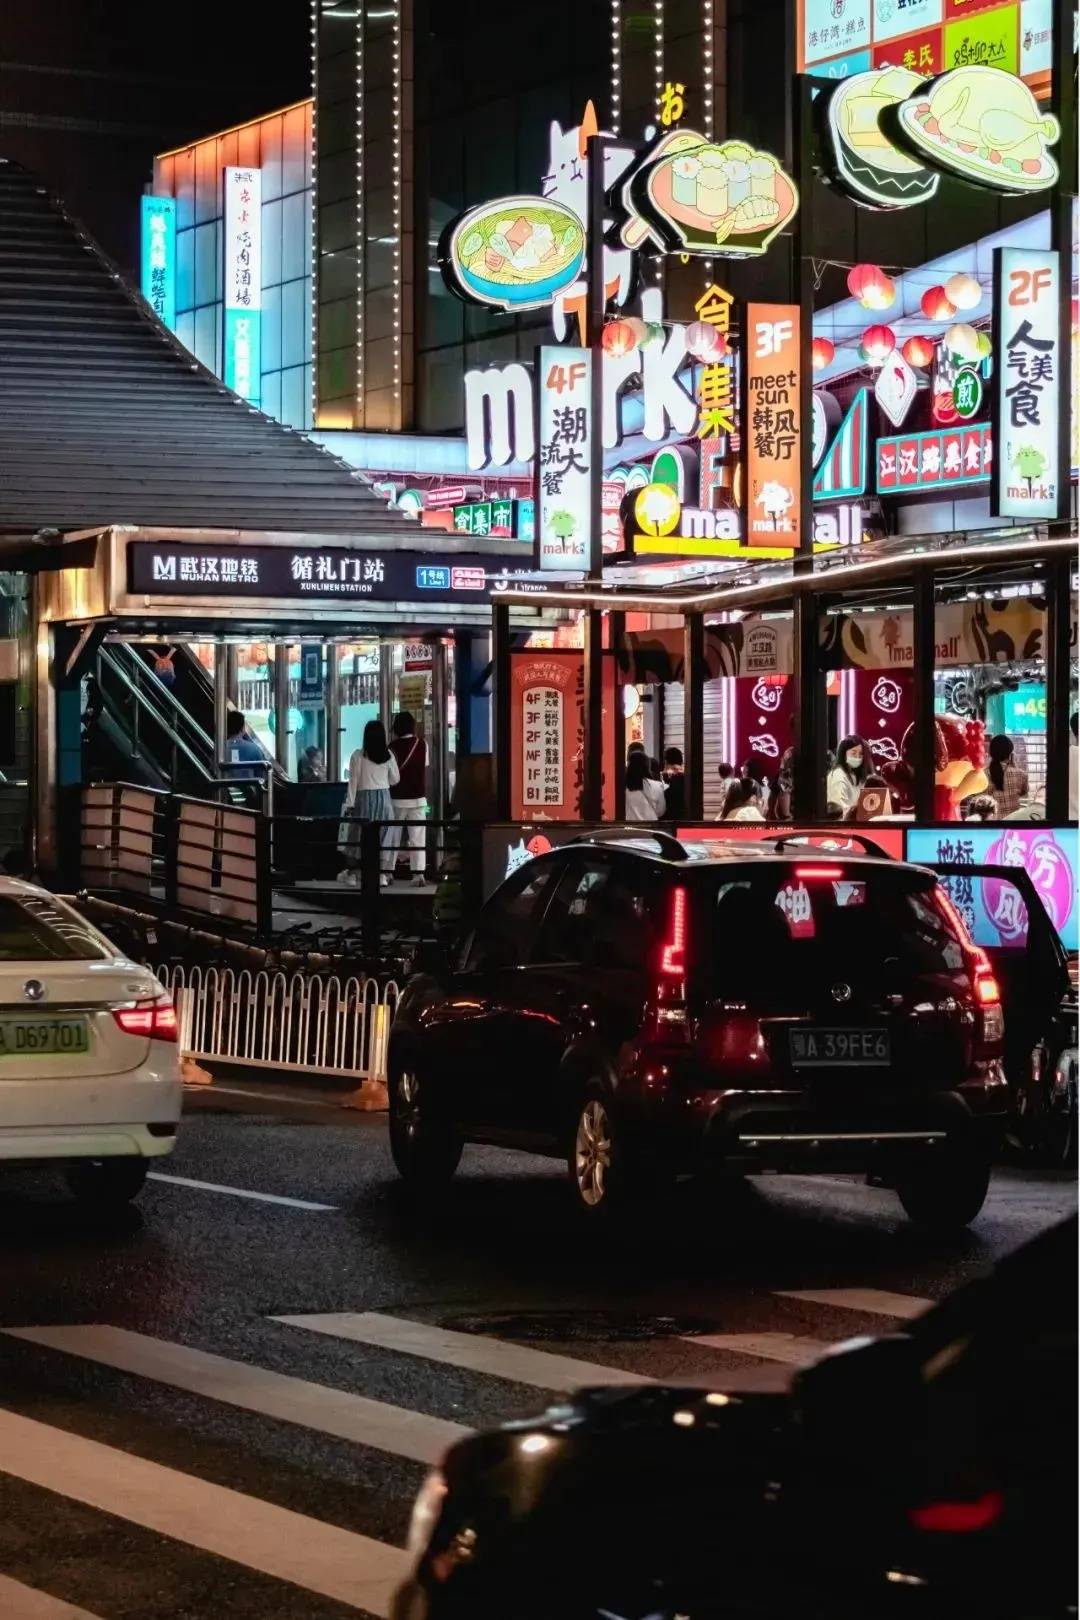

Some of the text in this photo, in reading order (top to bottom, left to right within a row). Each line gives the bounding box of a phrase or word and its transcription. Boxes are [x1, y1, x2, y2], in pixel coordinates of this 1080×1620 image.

[903, 44, 934, 70] 李氏
[1008, 268, 1053, 306] 2F
[755, 320, 793, 358] 3F
[546, 362, 587, 395] 4F
[750, 370, 798, 389] meet
[1005, 319, 1055, 427] 人气美食
[756, 389, 790, 406] sun
[752, 407, 800, 435] 韩风
[753, 436, 797, 462] 餐厅
[1007, 484, 1049, 500] mark
[753, 517, 793, 533] mark
[813, 503, 863, 545] all
[543, 543, 580, 555] mark
[180, 557, 258, 576] 武汉地铁
[290, 555, 385, 582] 循礼门站
[180, 573, 259, 583] WUHAN METRO
[300, 582, 373, 593] XUNLIMEN STATION
[526, 693, 540, 705] 4F
[526, 712, 540, 724] 3F
[526, 731, 540, 743] 2F
[526, 750, 541, 762] MF
[527, 768, 541, 781] 1F
[526, 787, 540, 800] B1
[16, 1024, 84, 1048] D69701
[824, 1034, 887, 1058] 39FE6
